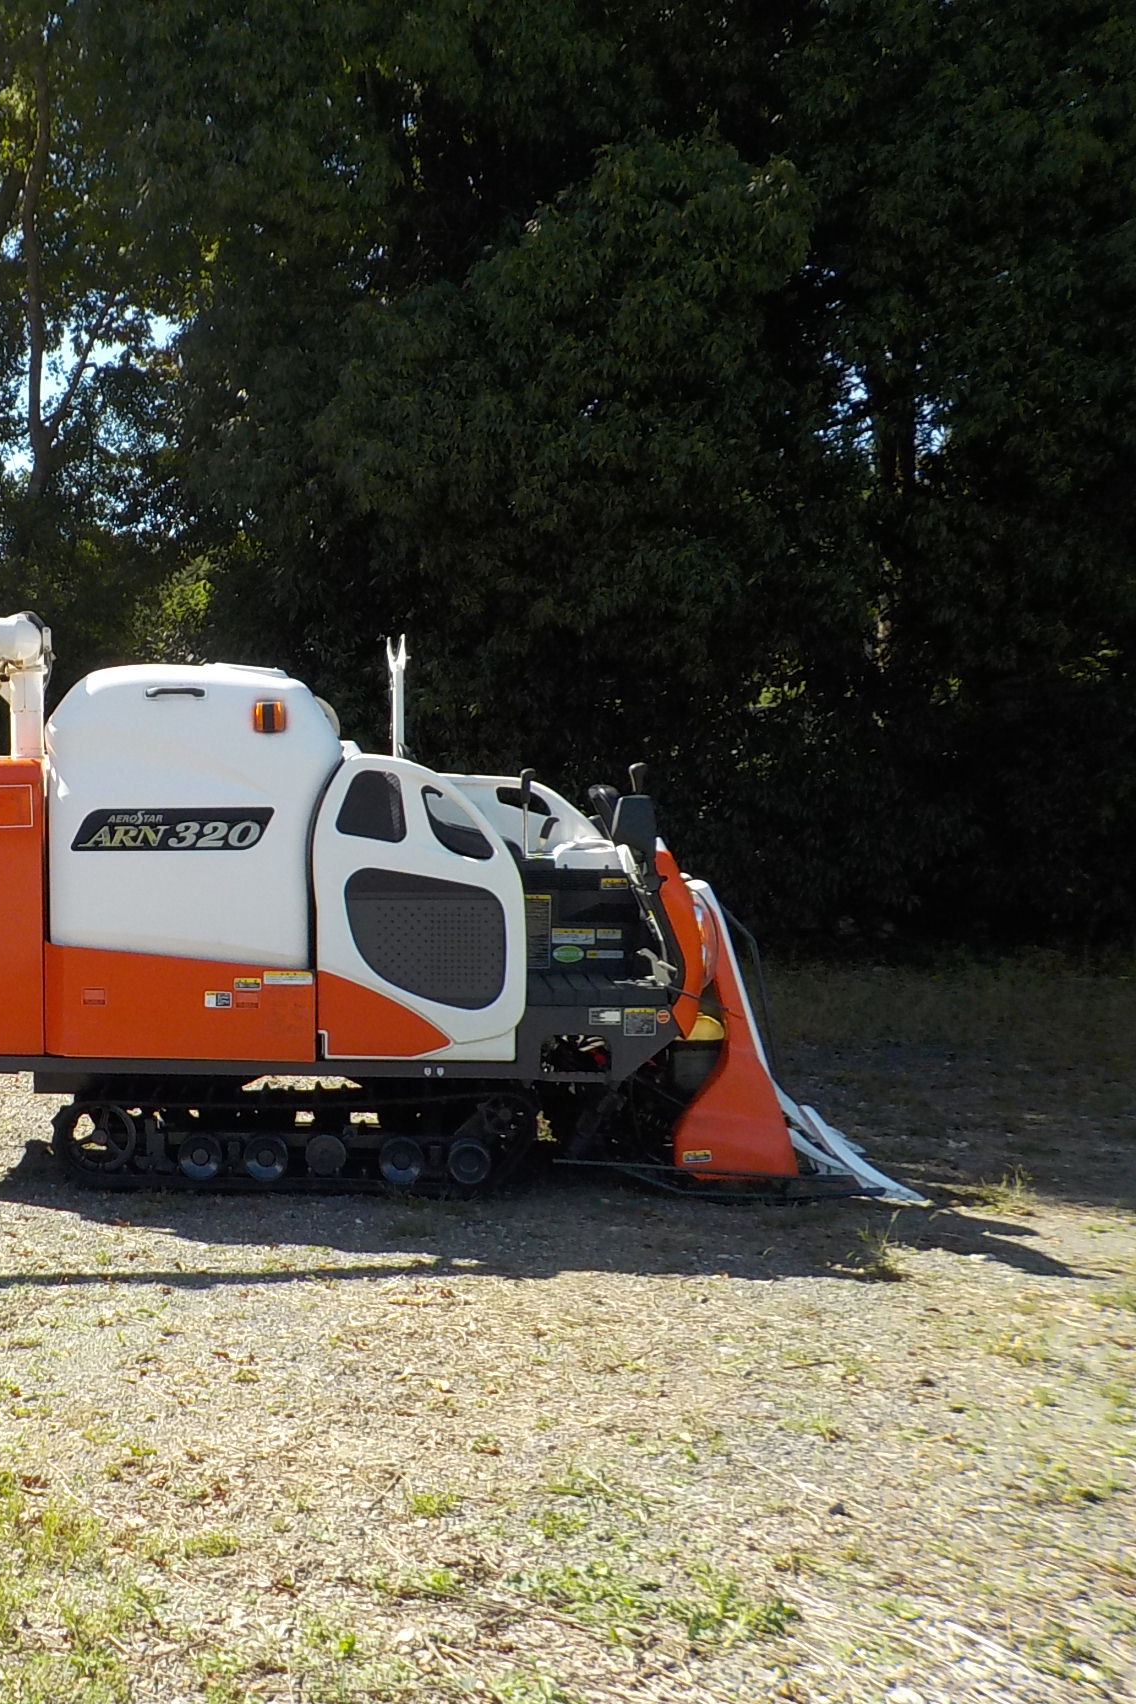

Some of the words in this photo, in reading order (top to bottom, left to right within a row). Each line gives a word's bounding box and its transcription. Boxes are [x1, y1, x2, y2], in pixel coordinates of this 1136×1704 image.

[107, 811, 163, 824] AEROSTAR
[78, 826, 170, 847] ARN
[168, 821, 261, 847] 320
